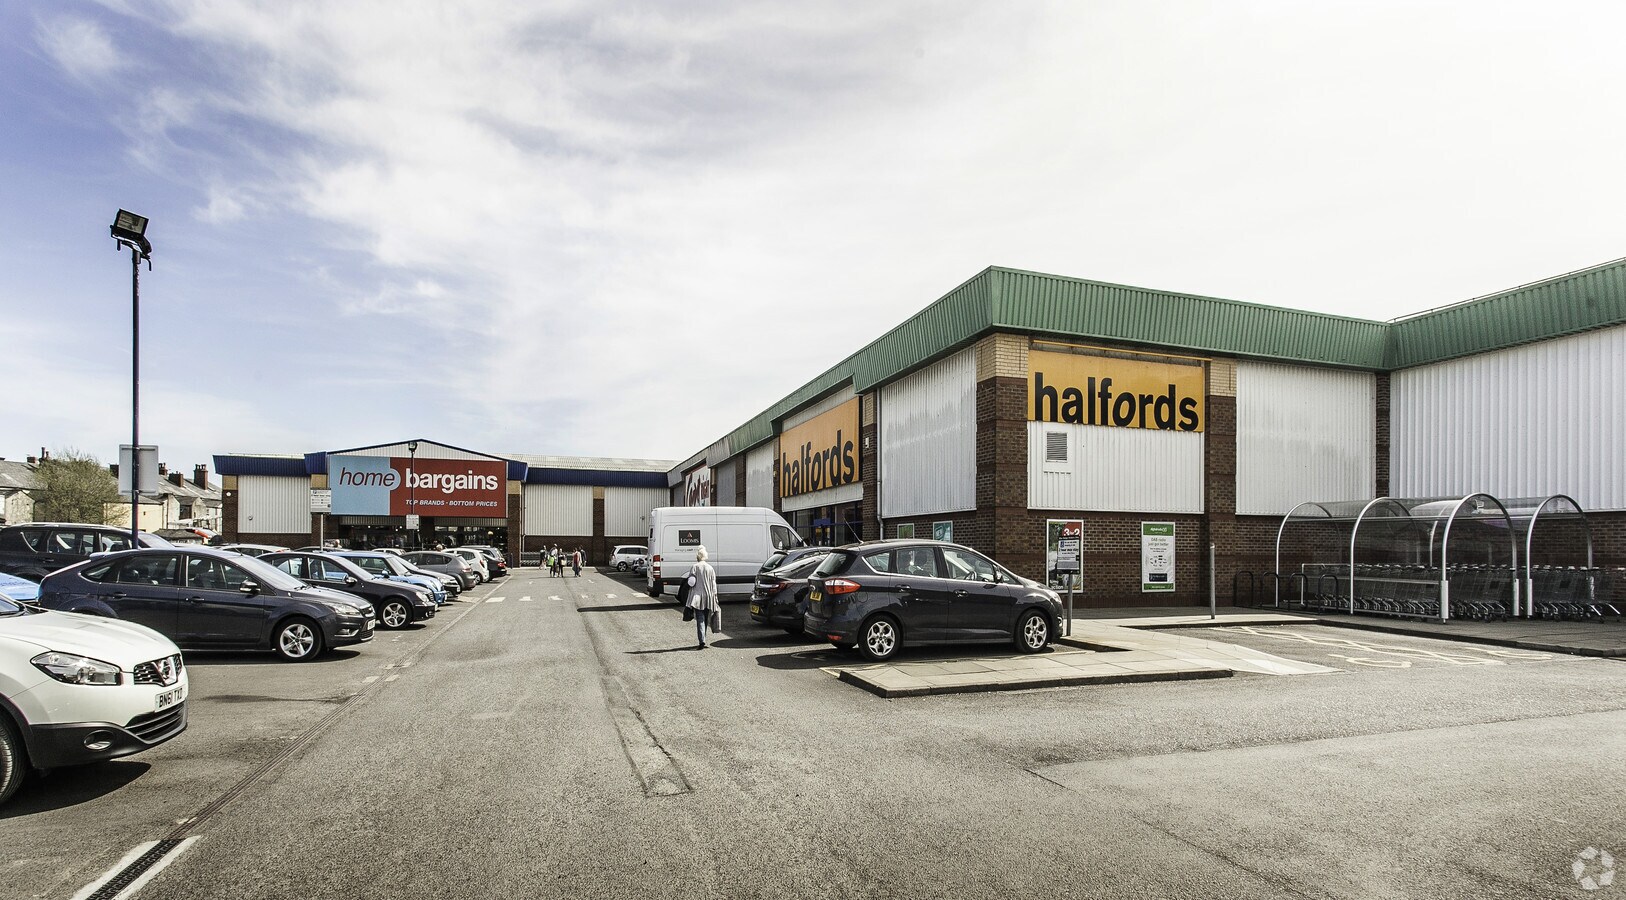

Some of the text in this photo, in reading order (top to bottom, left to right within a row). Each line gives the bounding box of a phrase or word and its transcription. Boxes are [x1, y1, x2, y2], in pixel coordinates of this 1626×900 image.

[1034, 371, 1200, 432] halfords
[339, 467, 499, 494] home bargains
[782, 429, 855, 497] halfords
